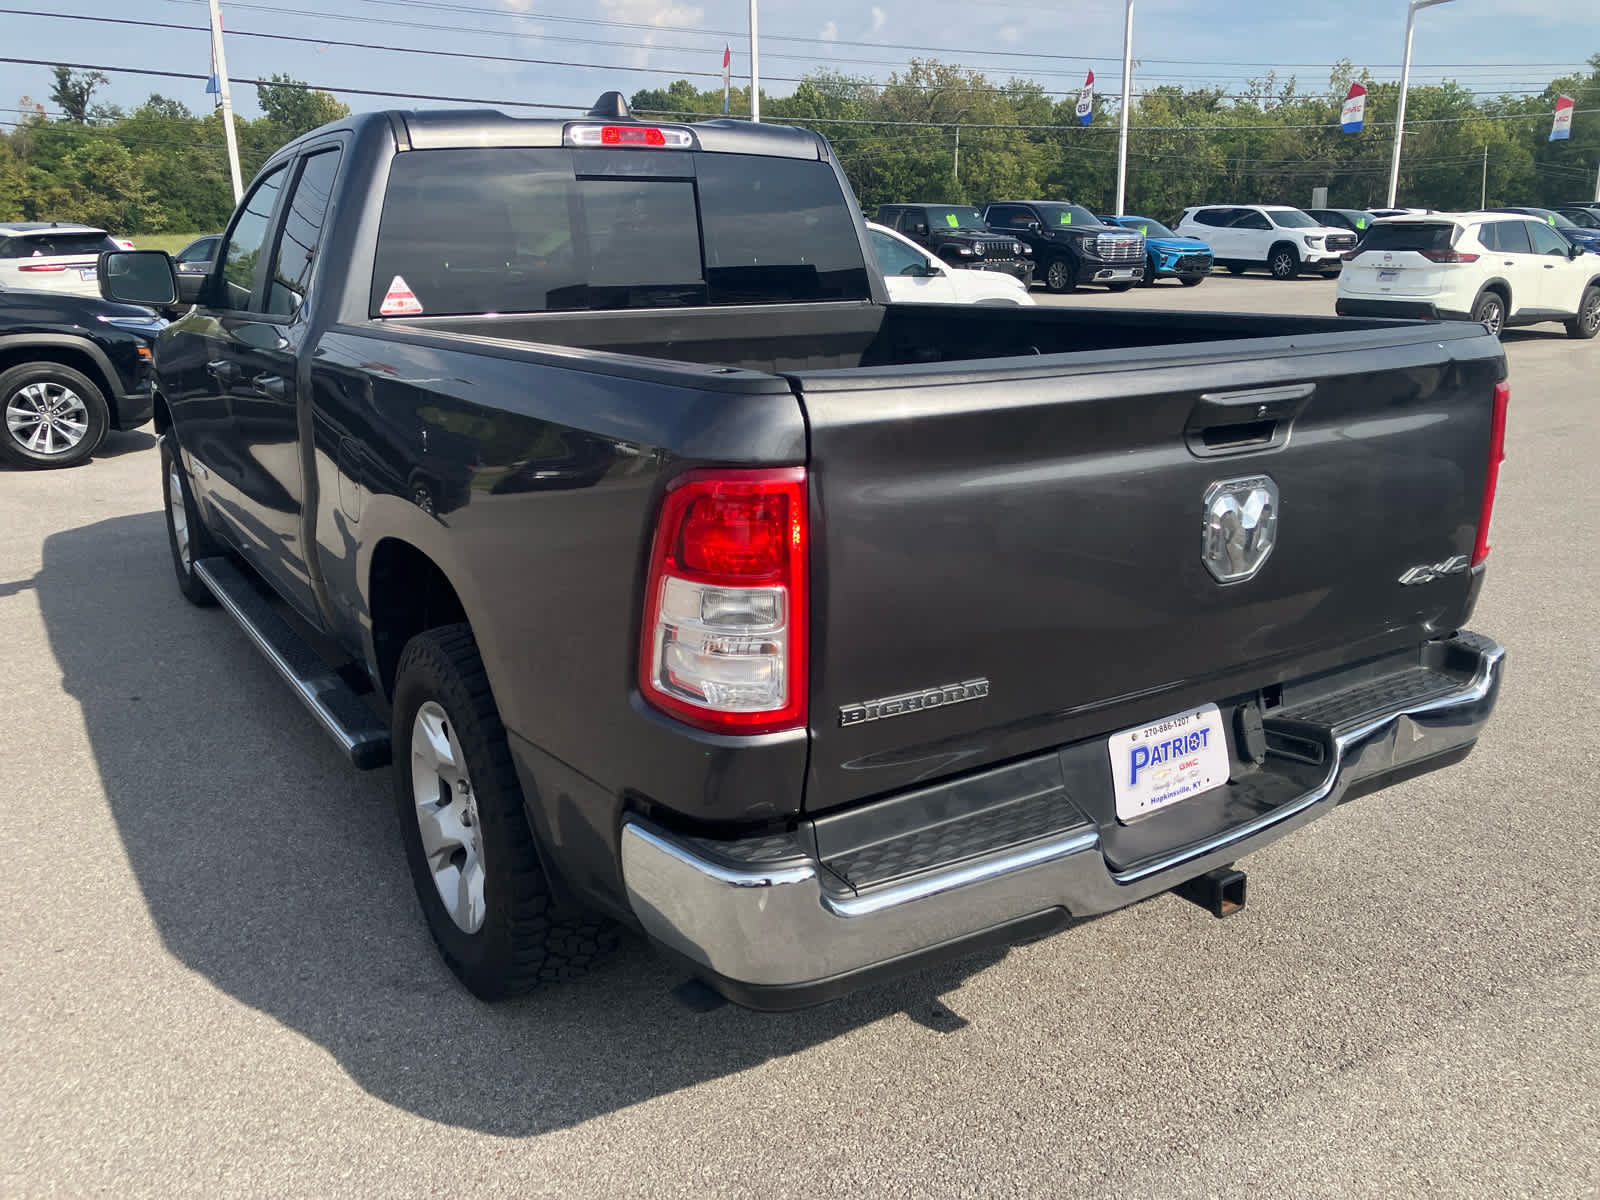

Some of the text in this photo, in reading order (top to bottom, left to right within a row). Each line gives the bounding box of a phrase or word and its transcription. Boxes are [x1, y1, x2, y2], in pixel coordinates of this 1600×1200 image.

[838, 677, 990, 727] BIGHORN
[1143, 716, 1189, 738] 270-886-1207
[1128, 727, 1210, 786] PATRIOT
[1178, 758, 1199, 771] GMC
[1150, 780, 1201, 805] Hopkinsville, KY
